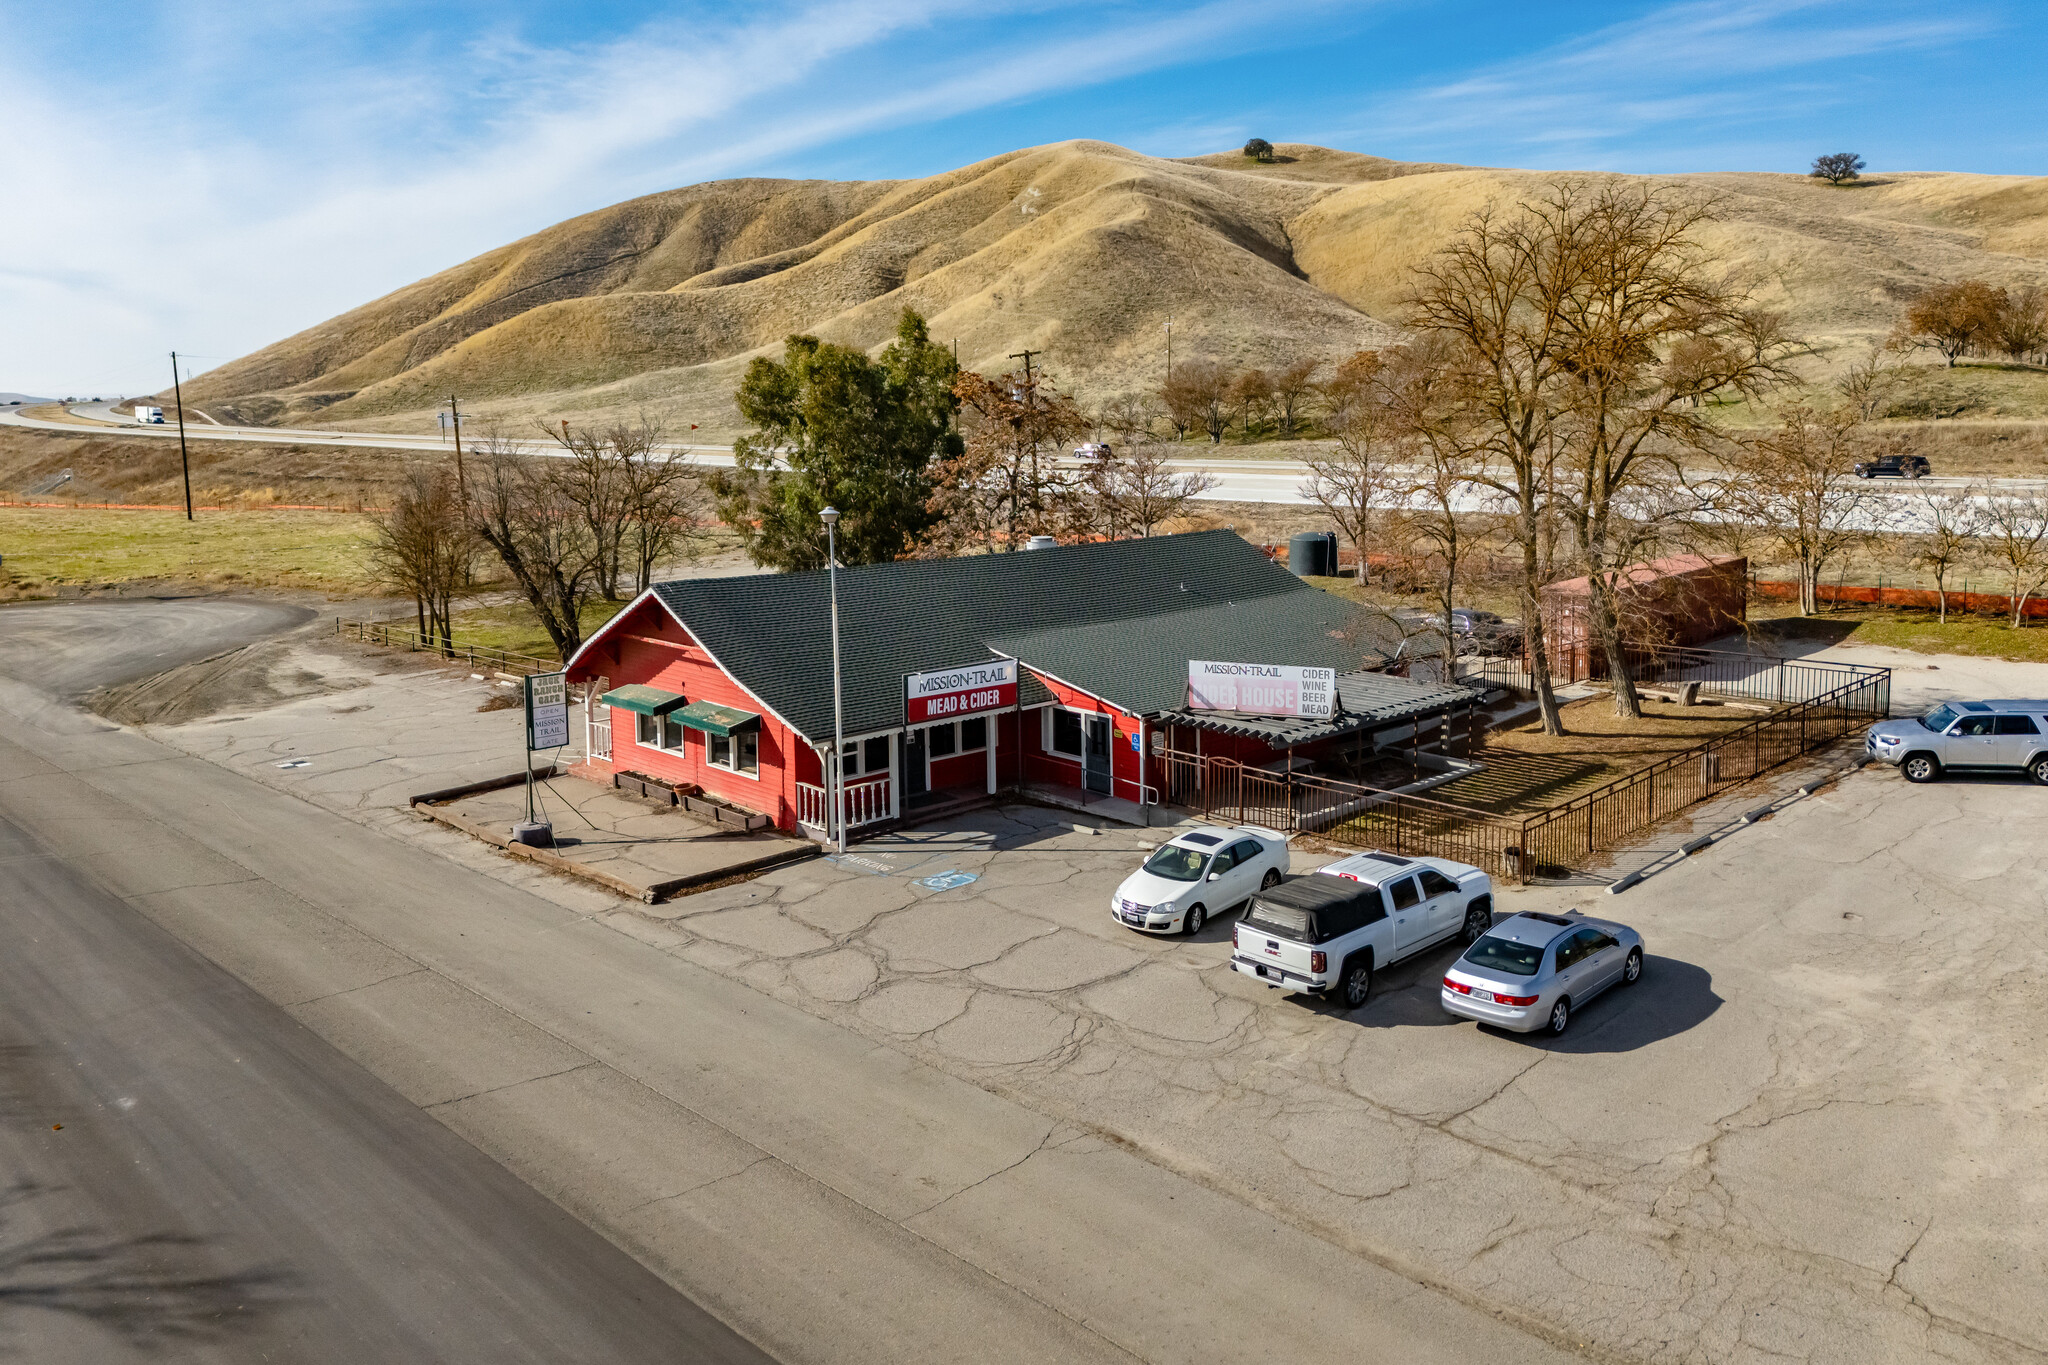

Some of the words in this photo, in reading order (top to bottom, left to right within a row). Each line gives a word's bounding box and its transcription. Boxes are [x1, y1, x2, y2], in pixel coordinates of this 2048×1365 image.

[1204, 664, 1281, 677] MISSION-TRAIL
[1302, 669, 1330, 680] CIDER
[537, 676, 559, 686] JACK
[919, 668, 1007, 692] MISSION-TRAIL
[534, 684, 563, 696] RANCH
[1302, 681, 1327, 691] WINE
[538, 694, 560, 705] CAFE
[927, 696, 957, 715] MEAD
[959, 694, 968, 710] &
[970, 689, 999, 708] CIDER
[1242, 686, 1294, 708] HOUSE
[1302, 692, 1326, 703] BEER
[1302, 704, 1329, 715] MEAD
[535, 718, 565, 728] MISSION
[540, 727, 561, 736] TRAIL
[542, 738, 559, 746] LATE
[839, 853, 894, 871] PARKING
[1264, 948, 1281, 957] GMC
